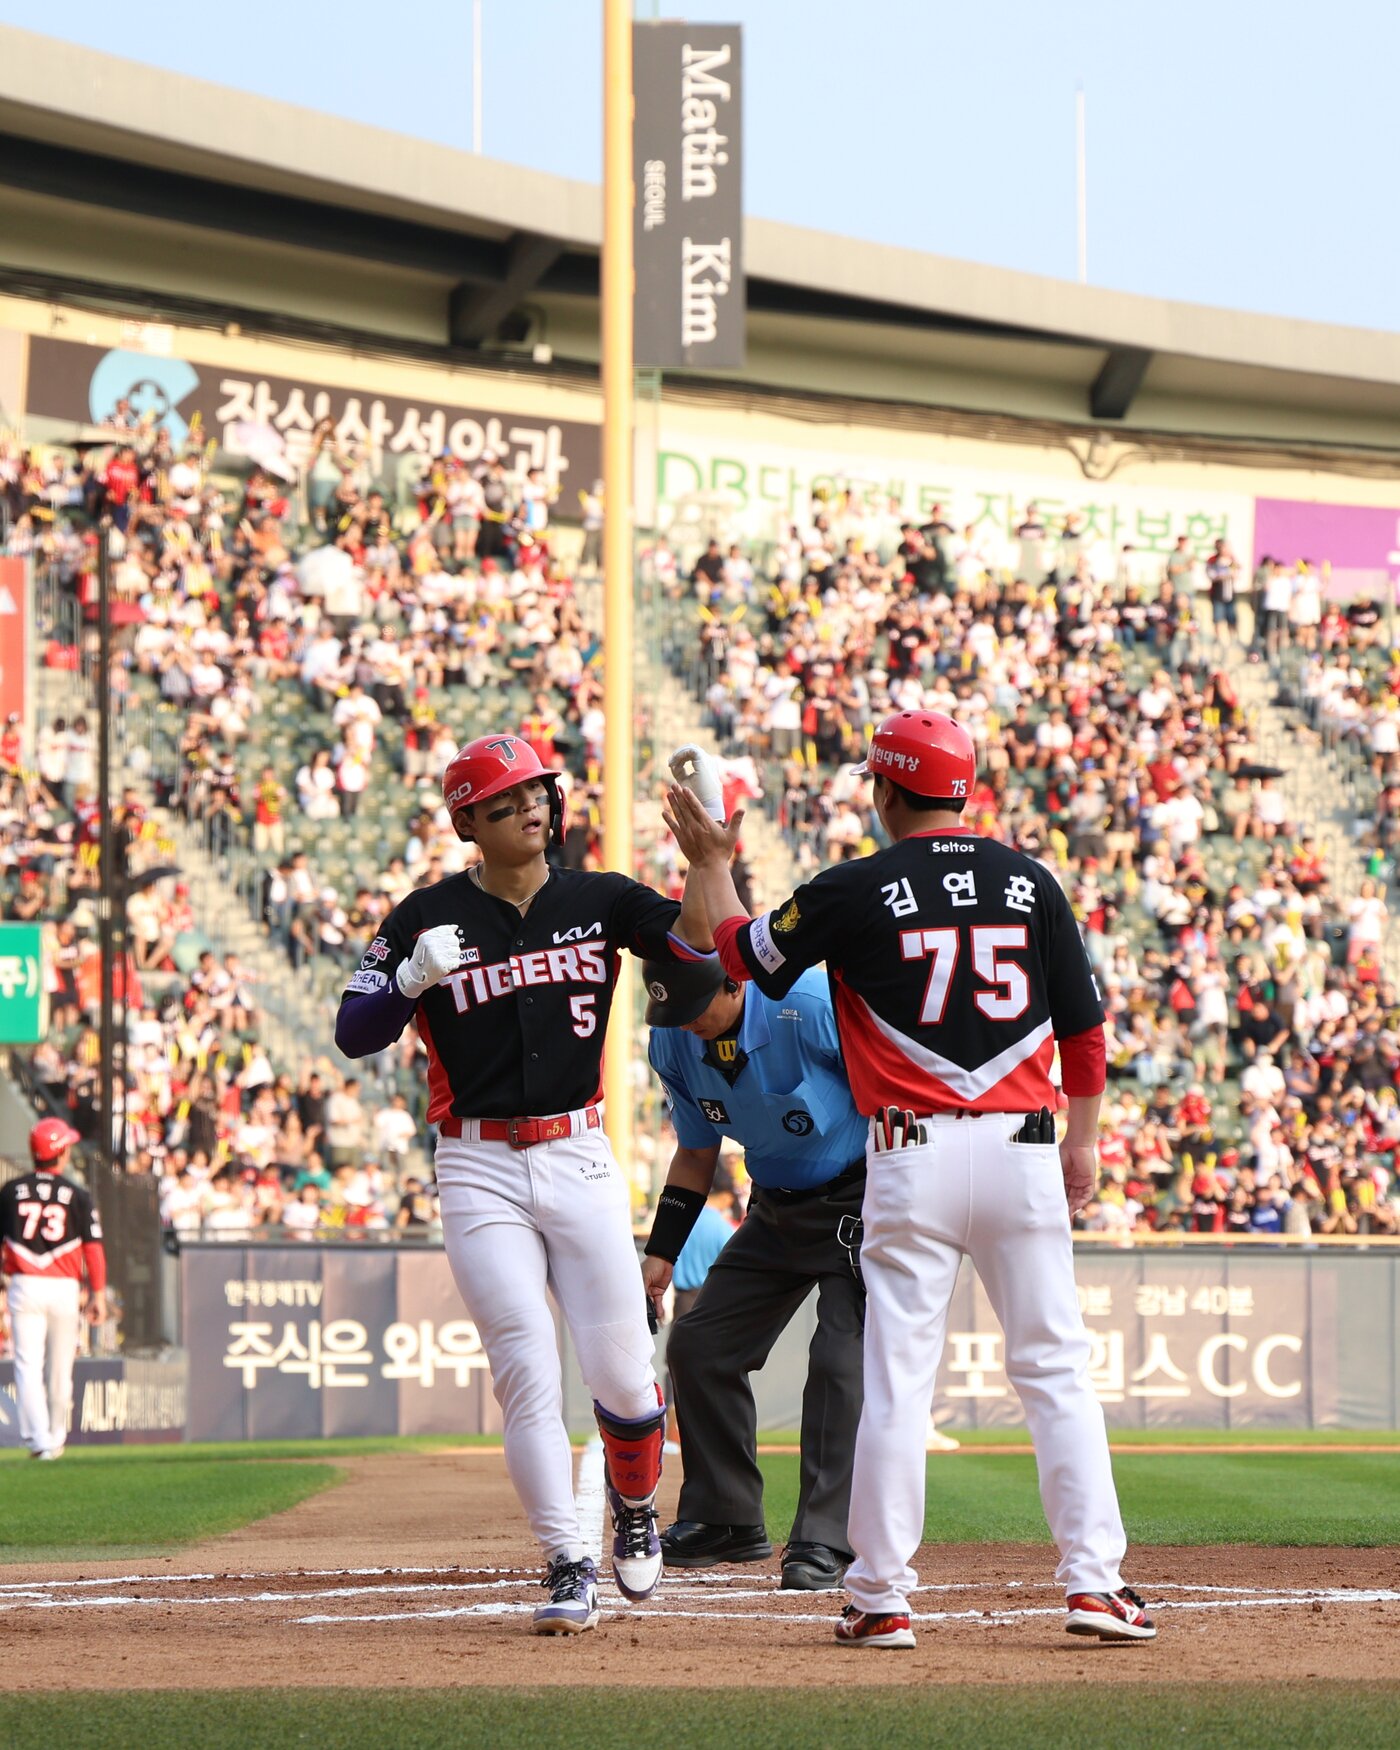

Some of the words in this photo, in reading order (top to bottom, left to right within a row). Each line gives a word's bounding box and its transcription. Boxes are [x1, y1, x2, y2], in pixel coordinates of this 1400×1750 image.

[682, 44, 731, 201] Matin
[644, 160, 666, 231] SEOUL
[682, 237, 731, 347] Kim
[447, 782, 472, 807] RO
[951, 780, 967, 795] 75
[932, 841, 975, 853] Seltos
[438, 940, 607, 1015] TIGERS
[899, 925, 1030, 1025] 75
[569, 994, 596, 1038] 5
[18, 1202, 67, 1242] 73
[223, 1320, 374, 1389] 주식은
[381, 1320, 490, 1388] 와우
